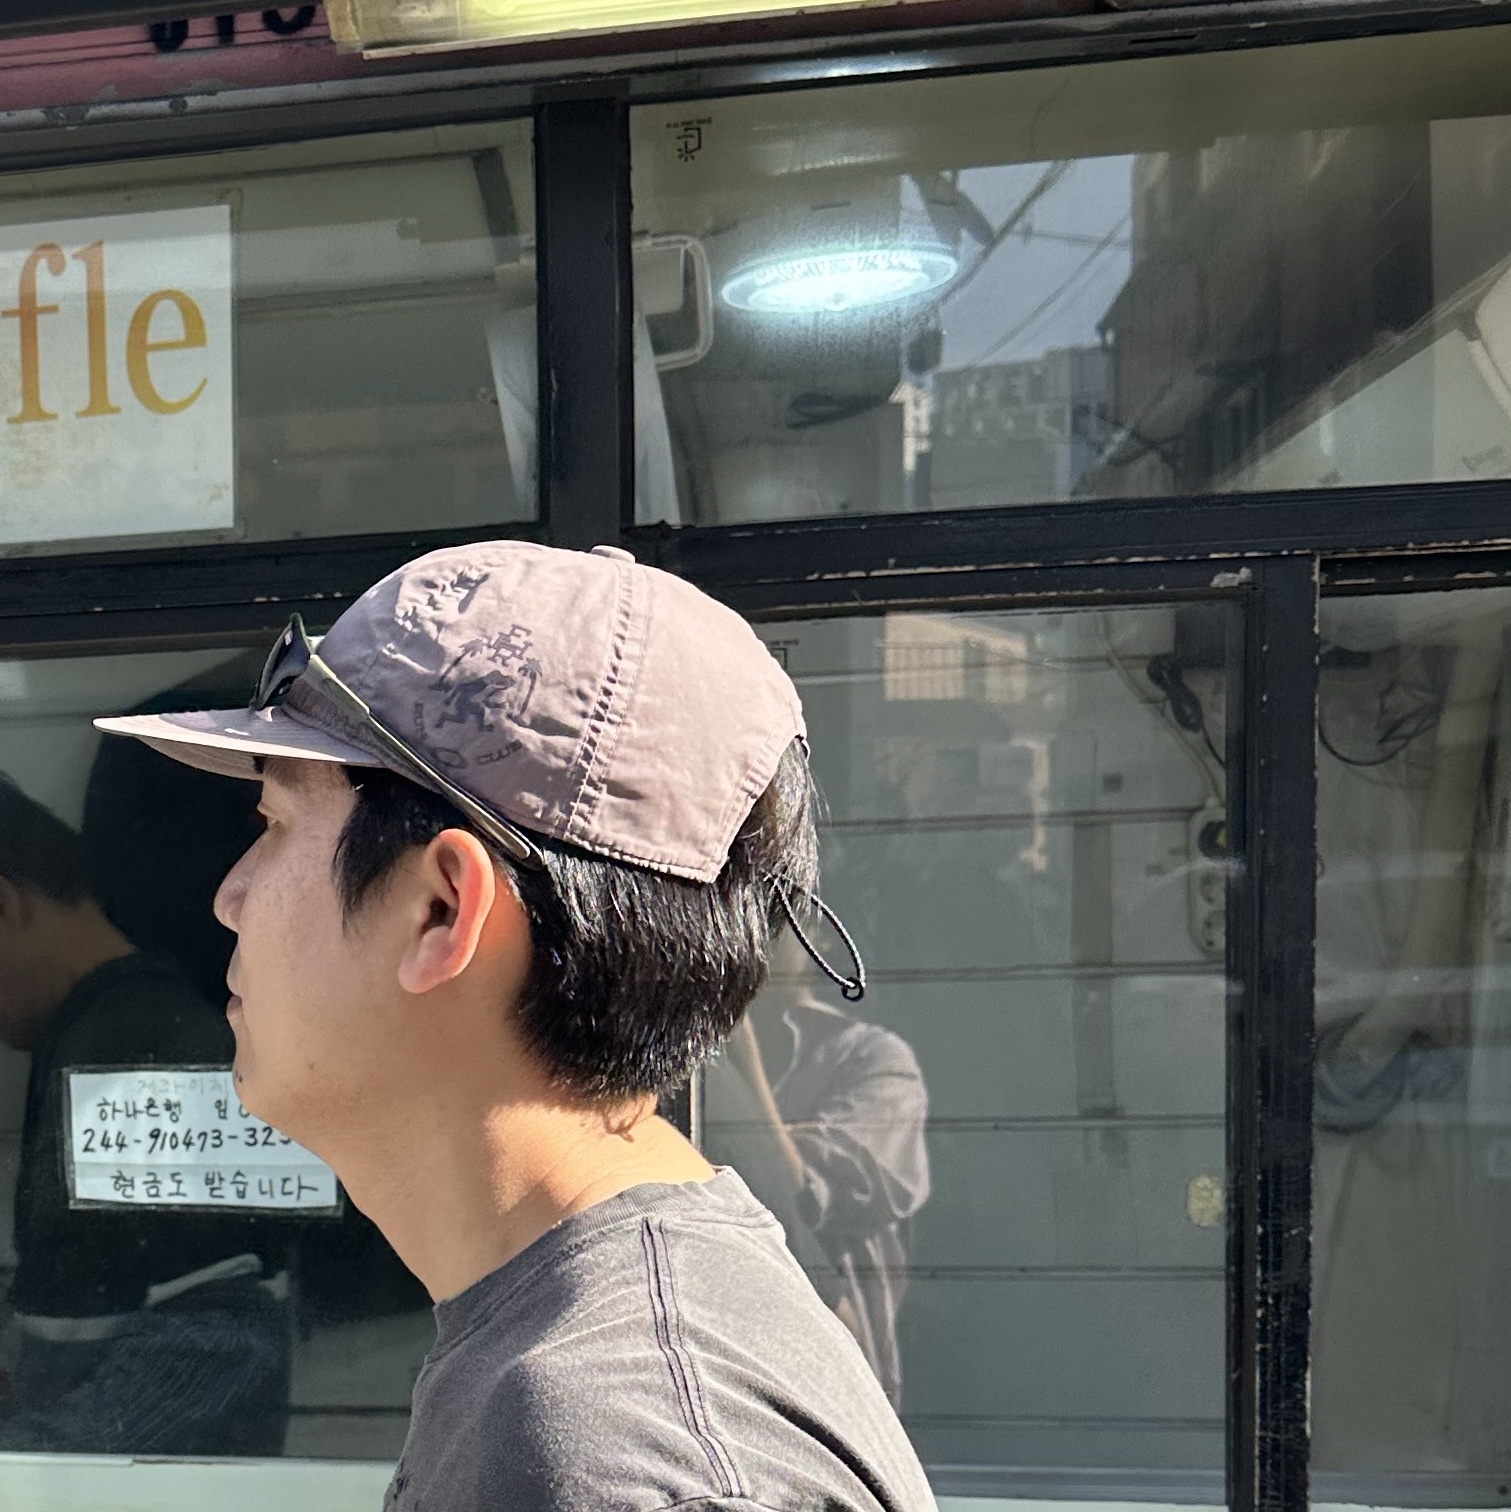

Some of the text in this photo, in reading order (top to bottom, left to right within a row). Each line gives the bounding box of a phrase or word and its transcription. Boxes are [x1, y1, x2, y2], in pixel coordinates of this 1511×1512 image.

[96, 1096, 182, 1123] 하나은행
[110, 1170, 318, 1200] 현금도 받습니다
